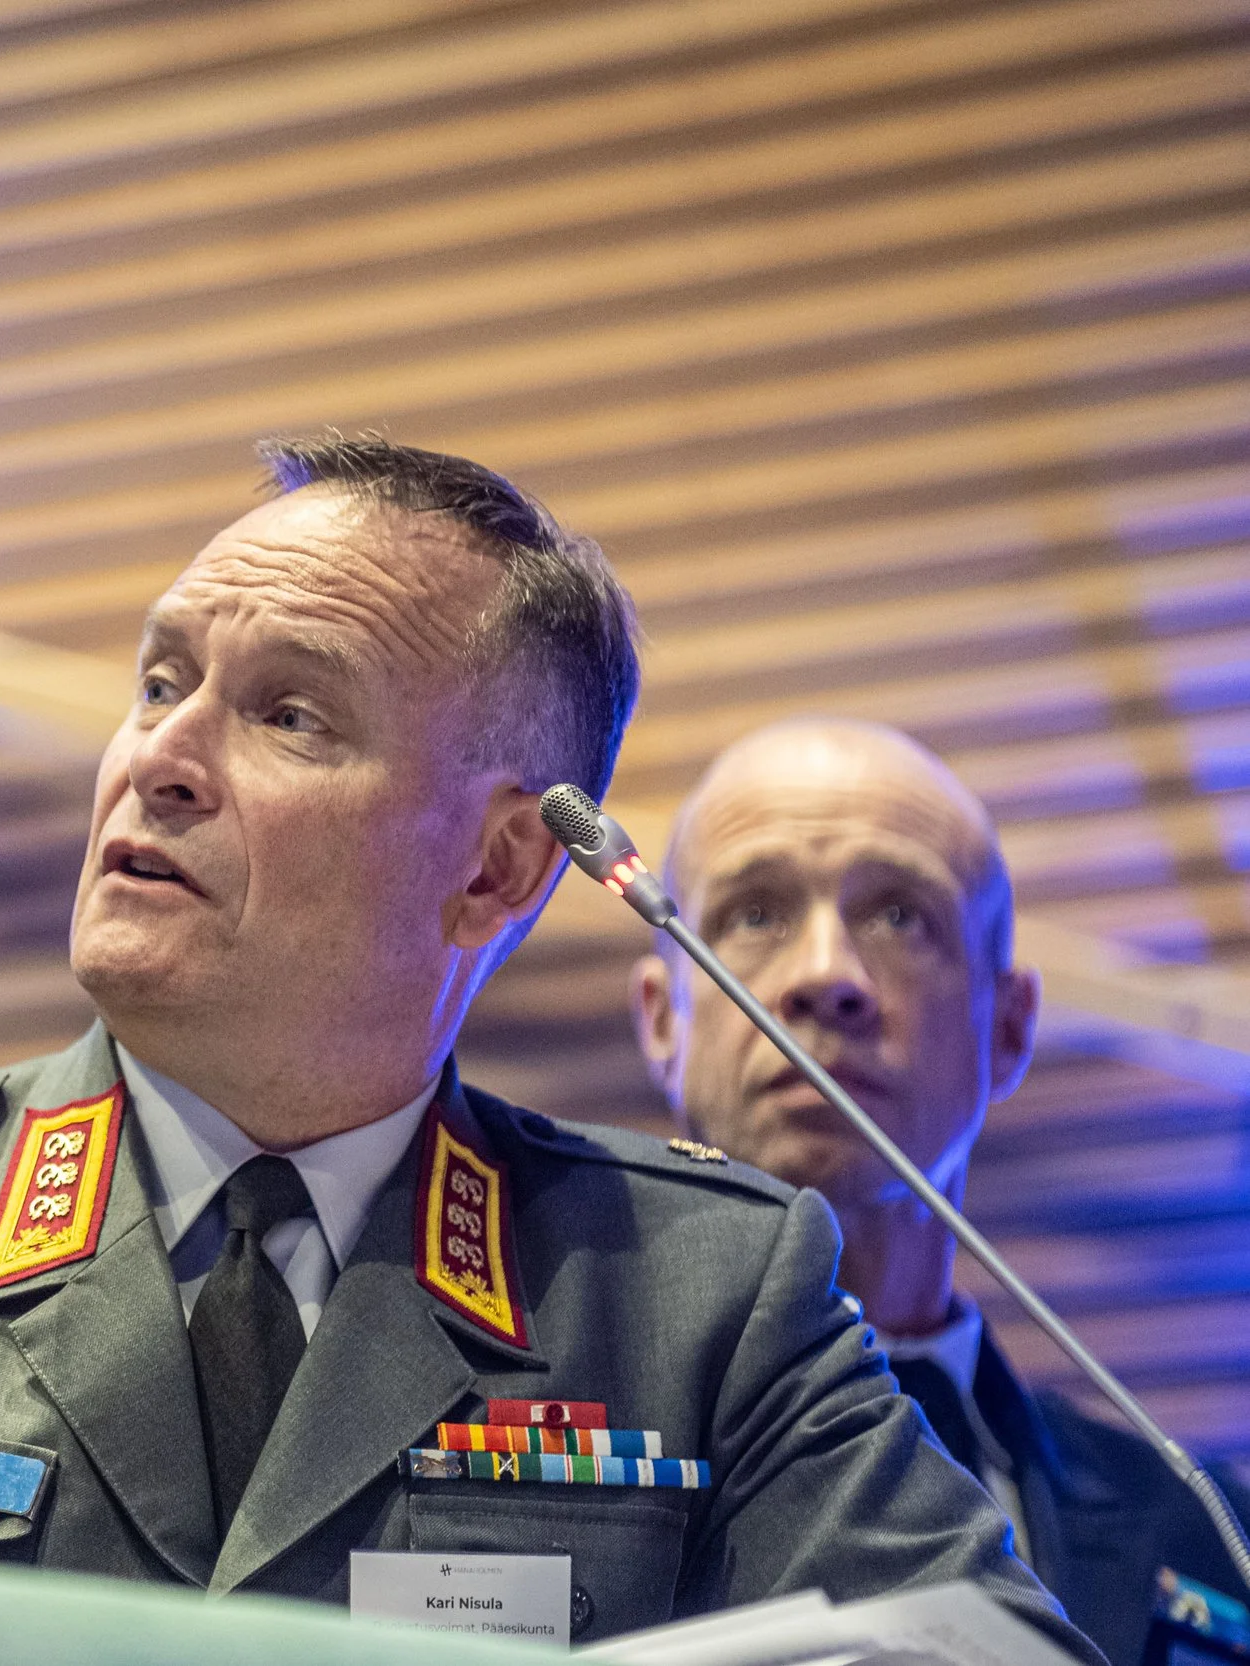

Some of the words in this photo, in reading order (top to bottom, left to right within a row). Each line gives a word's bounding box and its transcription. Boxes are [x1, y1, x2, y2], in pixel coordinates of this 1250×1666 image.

[426, 1596, 454, 1610] Kari
[459, 1597, 503, 1610] Nisula
[481, 1622, 555, 1636] Pääesikunta
